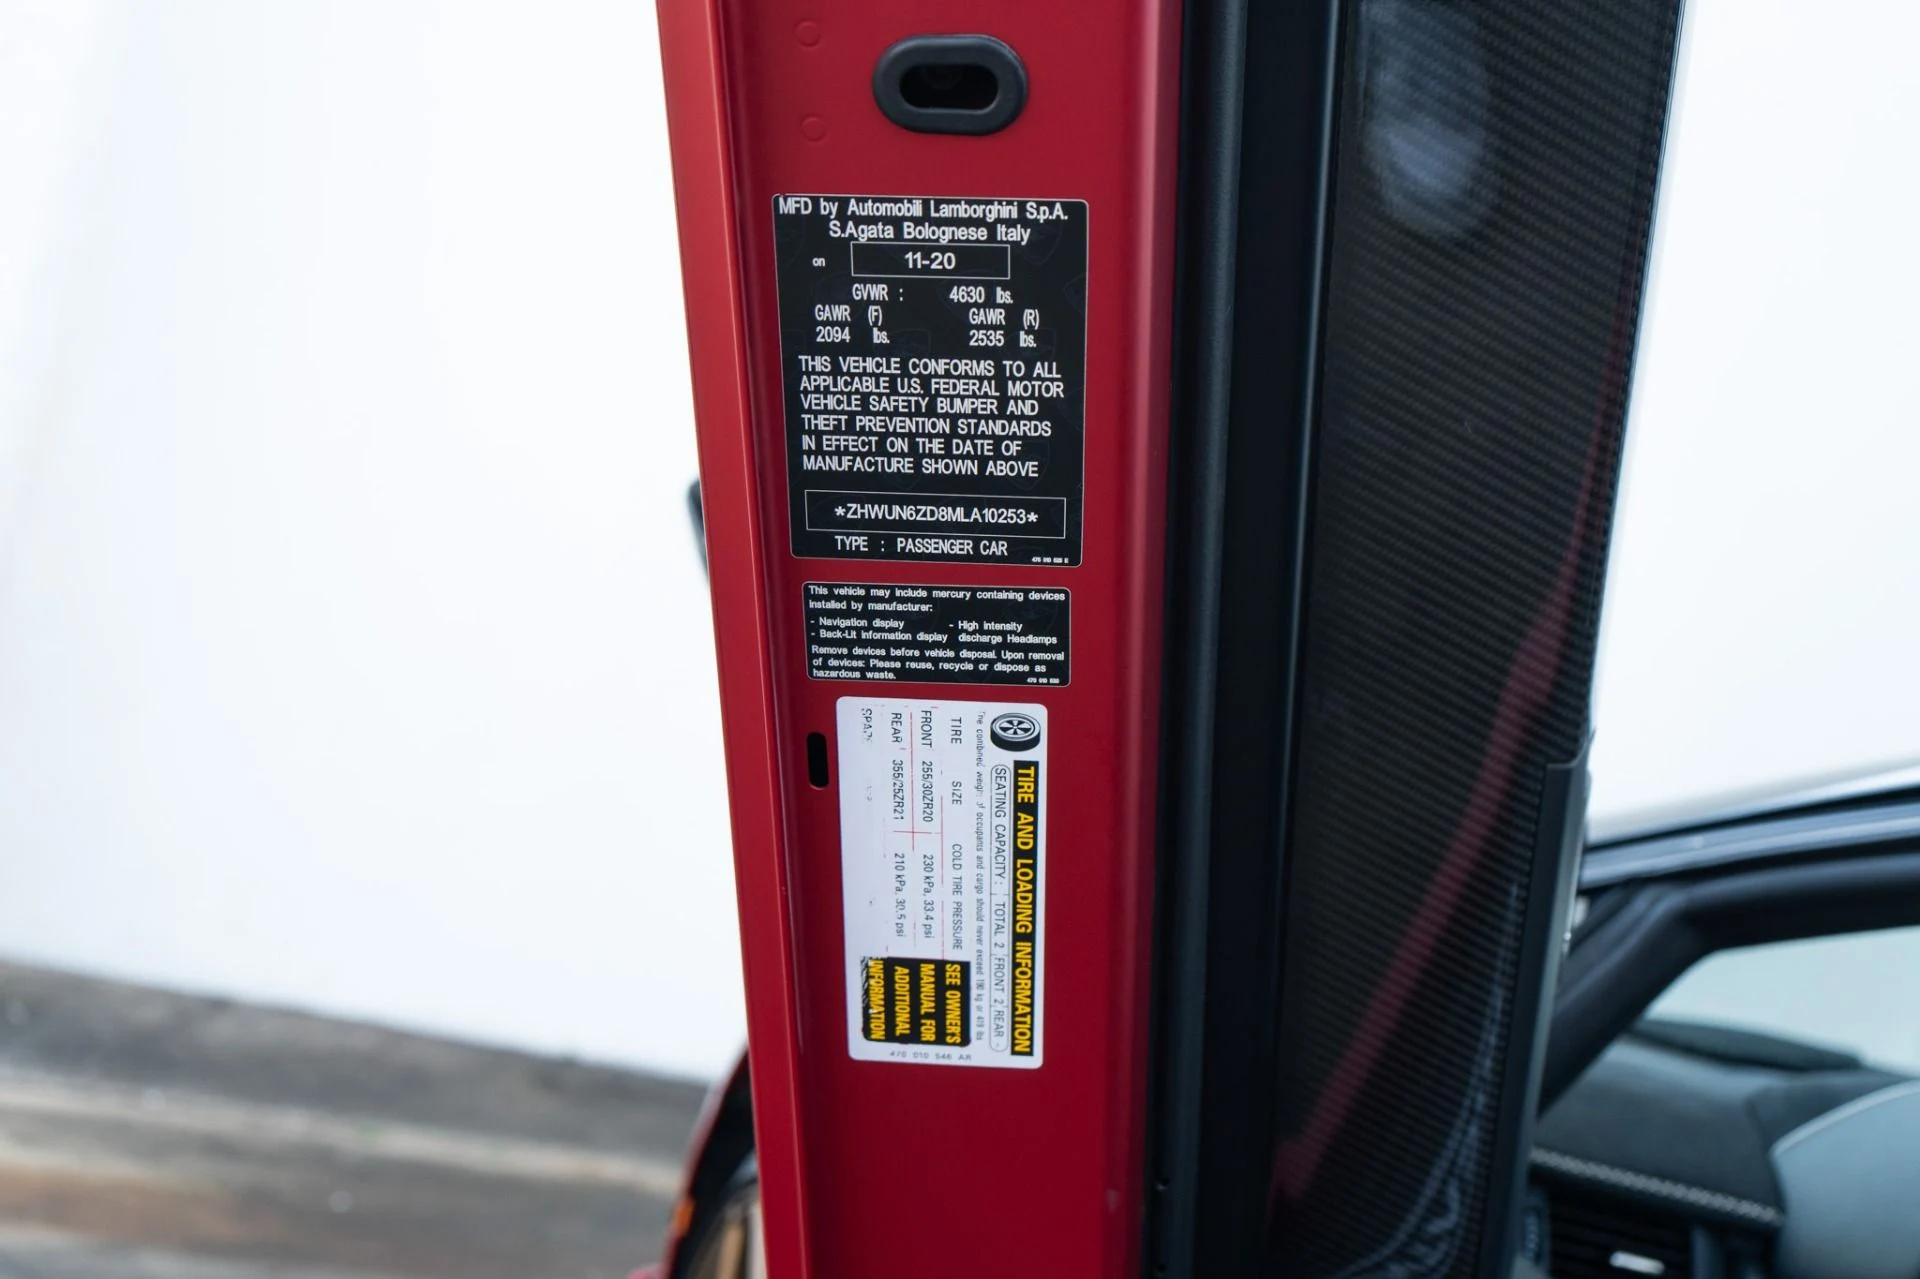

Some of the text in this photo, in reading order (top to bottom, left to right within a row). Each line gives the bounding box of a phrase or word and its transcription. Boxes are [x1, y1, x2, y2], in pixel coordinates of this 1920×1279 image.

[779, 196, 1068, 223] MFD by Automobili Lamborghini S.p.A.
[829, 220, 1030, 247] S.Agata Bolognese Italy
[813, 252, 955, 269] on 11-20
[852, 284, 888, 300] GVWR
[950, 286, 985, 303] 4630
[996, 287, 1013, 303] lbs.
[815, 304, 882, 326] GAWR (F)
[969, 308, 1039, 330] GAWR (R)
[816, 326, 890, 343] 2094 lbs.
[969, 330, 1036, 347] 2535 lbs.
[798, 356, 1061, 378] THIS VEHICLE CONFORMS TO ALL
[800, 375, 1064, 397] APPLICABLE U.S. FEDERAL MOTOR
[801, 394, 1038, 415] VEHICLE SAFETY BUMPER AND
[801, 414, 1051, 436] THEFT PREVENTION STANDARDS
[802, 435, 1022, 456] IN EFFECT ON THE DATE OF
[803, 455, 1038, 476] MANUFACTURE SHOWN ABOVE
[835, 536, 868, 551] TYPE
[897, 538, 973, 554] PASSENGER
[980, 540, 1007, 555] CAR
[808, 585, 1065, 601] This vehicle may include mercury containing devices
[809, 600, 932, 611] installed by manufacturer:
[820, 617, 904, 629] Navigation display
[959, 621, 1022, 632] High intensity
[820, 629, 948, 643] Back-Lit information display
[959, 633, 1057, 645] discharge Headlamps
[812, 645, 1064, 661] Remove devices before vehicle disposal. Upon removal
[813, 657, 822, 665] of
[828, 658, 865, 667] devices:
[870, 659, 901, 668] Please
[906, 662, 934, 670] reuse,
[939, 662, 973, 671] recycle
[994, 662, 1029, 673] dispose
[813, 668, 896, 679] hazardous waste.
[891, 712, 902, 743] REAR
[921, 710, 932, 748] FRONT
[892, 760, 904, 820] 355/25ZR21
[922, 761, 933, 822] 255/30ZR20
[995, 768, 1006, 817] SEATING
[951, 717, 962, 949] TIRE SIZE COLD TIRE PRESSURE
[975, 813, 984, 851] occupants
[894, 853, 904, 870] 210
[923, 854, 934, 873] 230
[976, 856, 984, 869] and
[975, 873, 984, 894] cargo
[924, 900, 934, 921] 33.4
[976, 898, 985, 921] should
[994, 902, 1005, 936] TOTAL
[1014, 766, 1034, 1051] TIRE AND LOADING INFORMATION
[895, 922, 906, 937] psi
[922, 924, 934, 938] psi
[976, 950, 985, 975] exceed
[994, 958, 1005, 992] FRONT
[869, 960, 885, 1040] INFORMATION
[895, 966, 910, 1036] ADDITIONAL
[920, 964, 935, 1041] MANUAL FOR
[946, 964, 961, 1043] SEE OWNER'S
[974, 994, 985, 1002] kg
[994, 999, 1006, 1007] 2
[994, 1010, 1004, 1037] REAR
